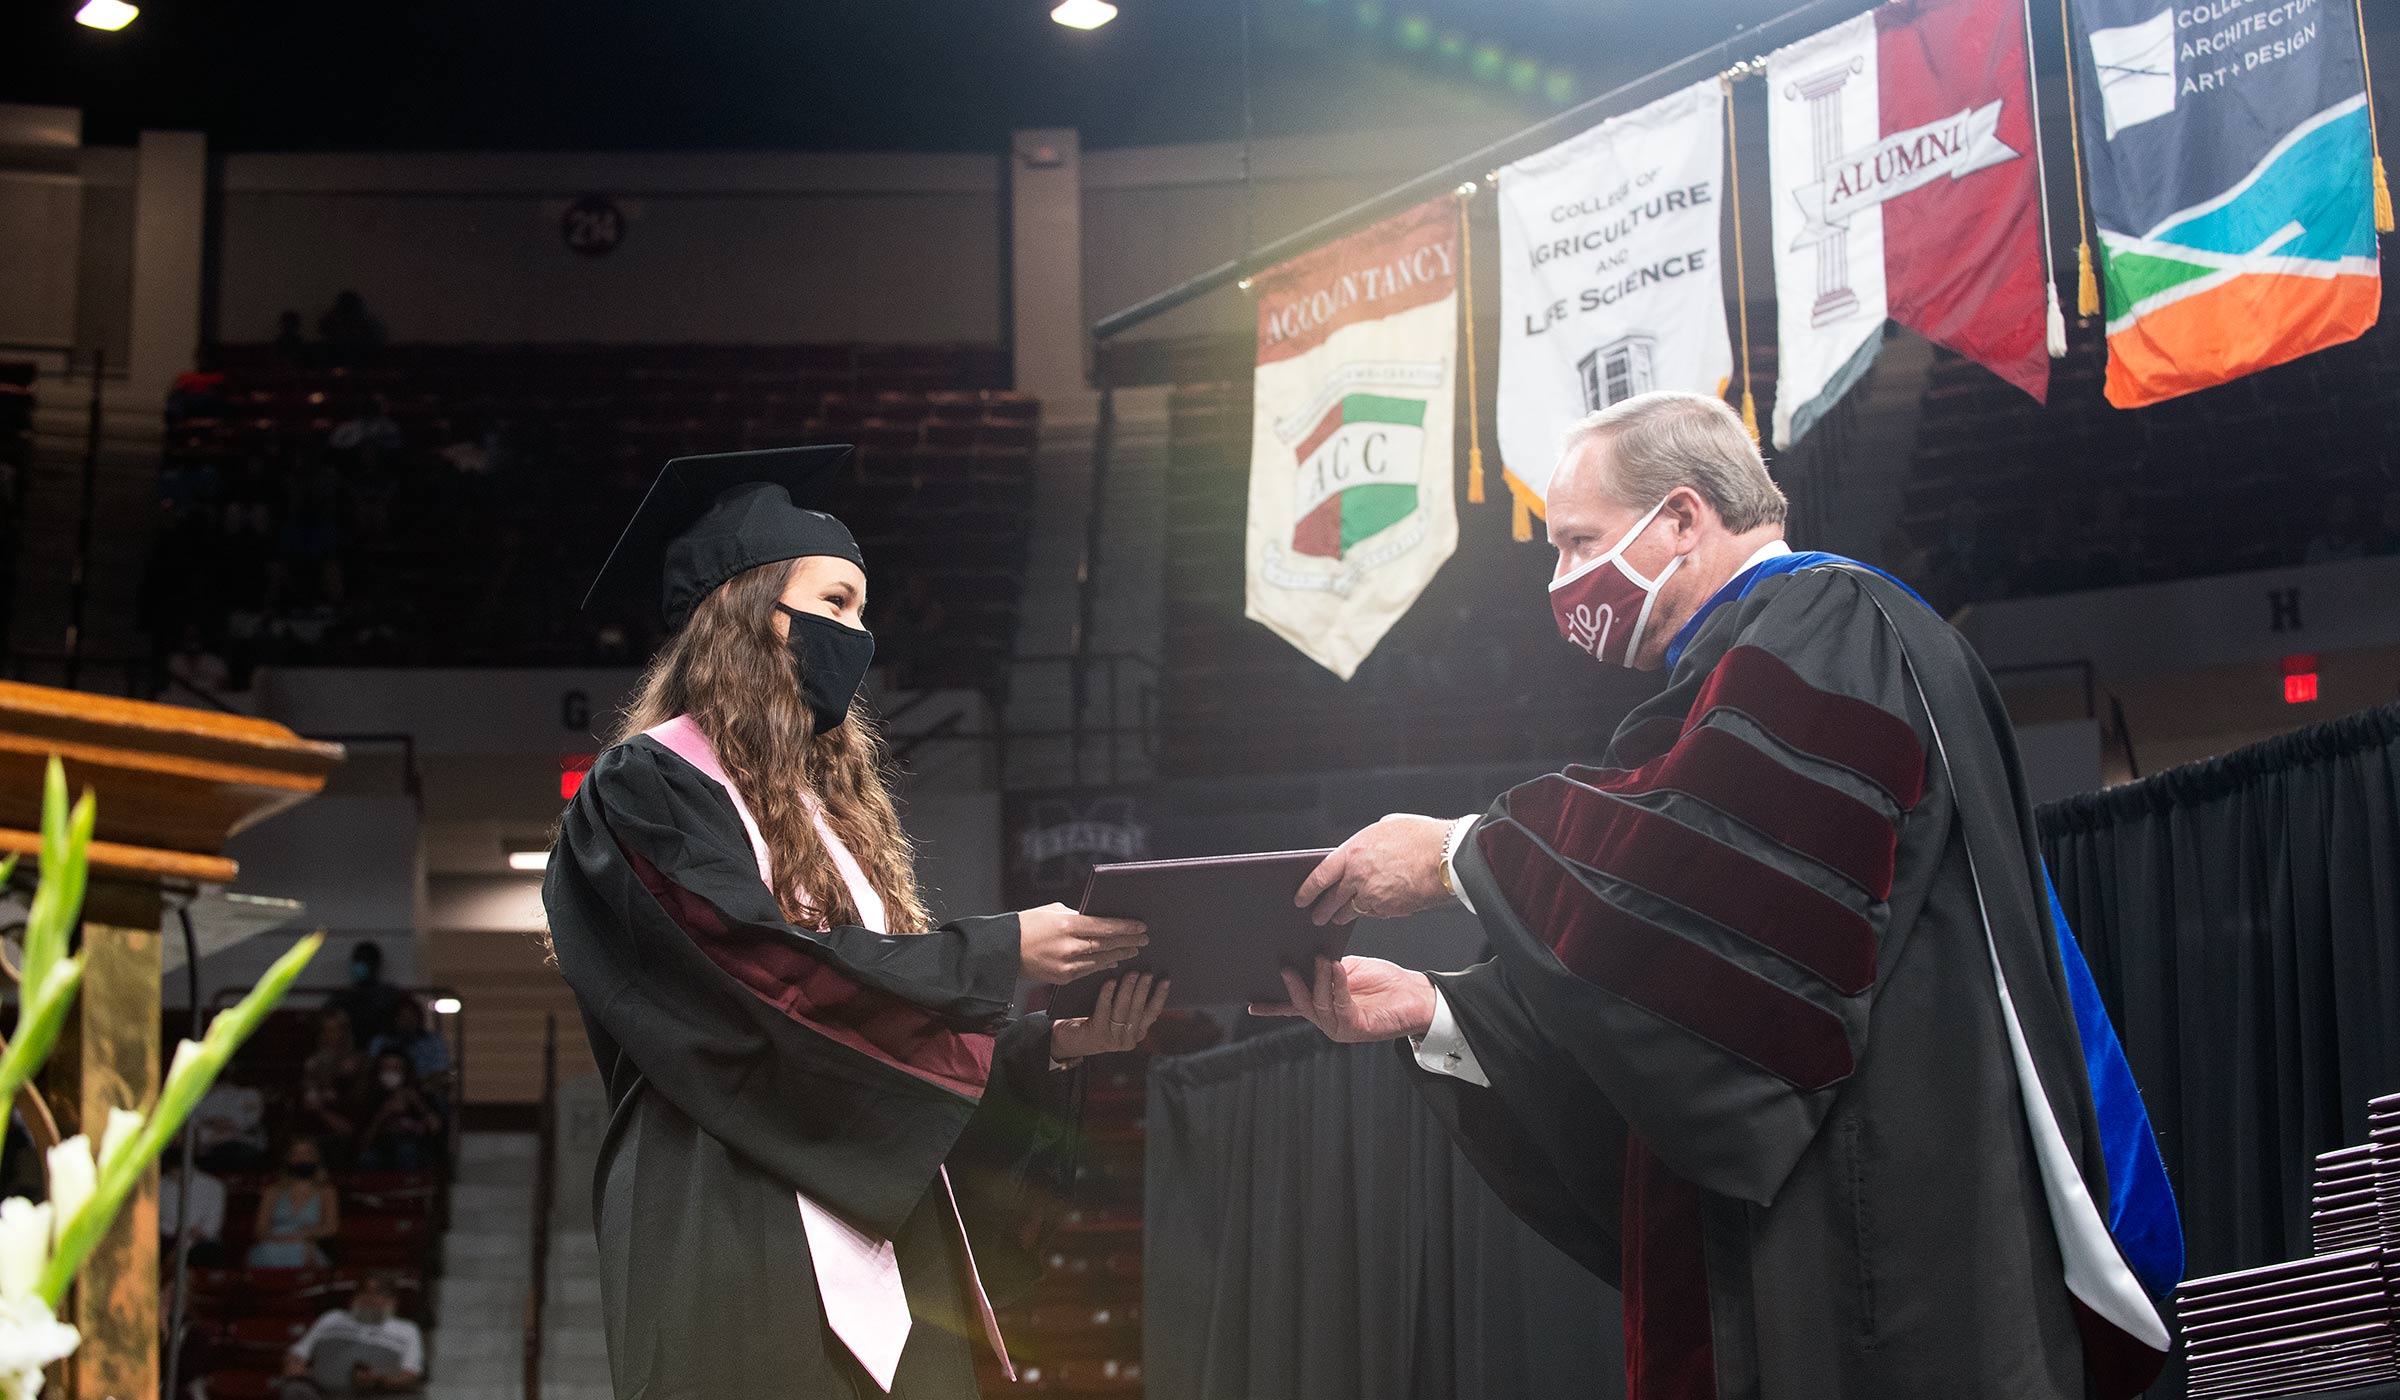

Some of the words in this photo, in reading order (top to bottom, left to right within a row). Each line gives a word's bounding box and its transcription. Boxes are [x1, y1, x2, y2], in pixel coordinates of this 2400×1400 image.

[2177, 0, 2252, 29] COLLE
[2181, 67, 2227, 97] ART
[2244, 21, 2316, 71] DESIGN
[1829, 124, 1962, 204] ALUMNI
[569, 210, 616, 246] 214
[1579, 248, 1706, 312] SCIENCE
[1308, 431, 1387, 502] ACC
[2268, 588, 2301, 630] H
[562, 690, 590, 731] G
